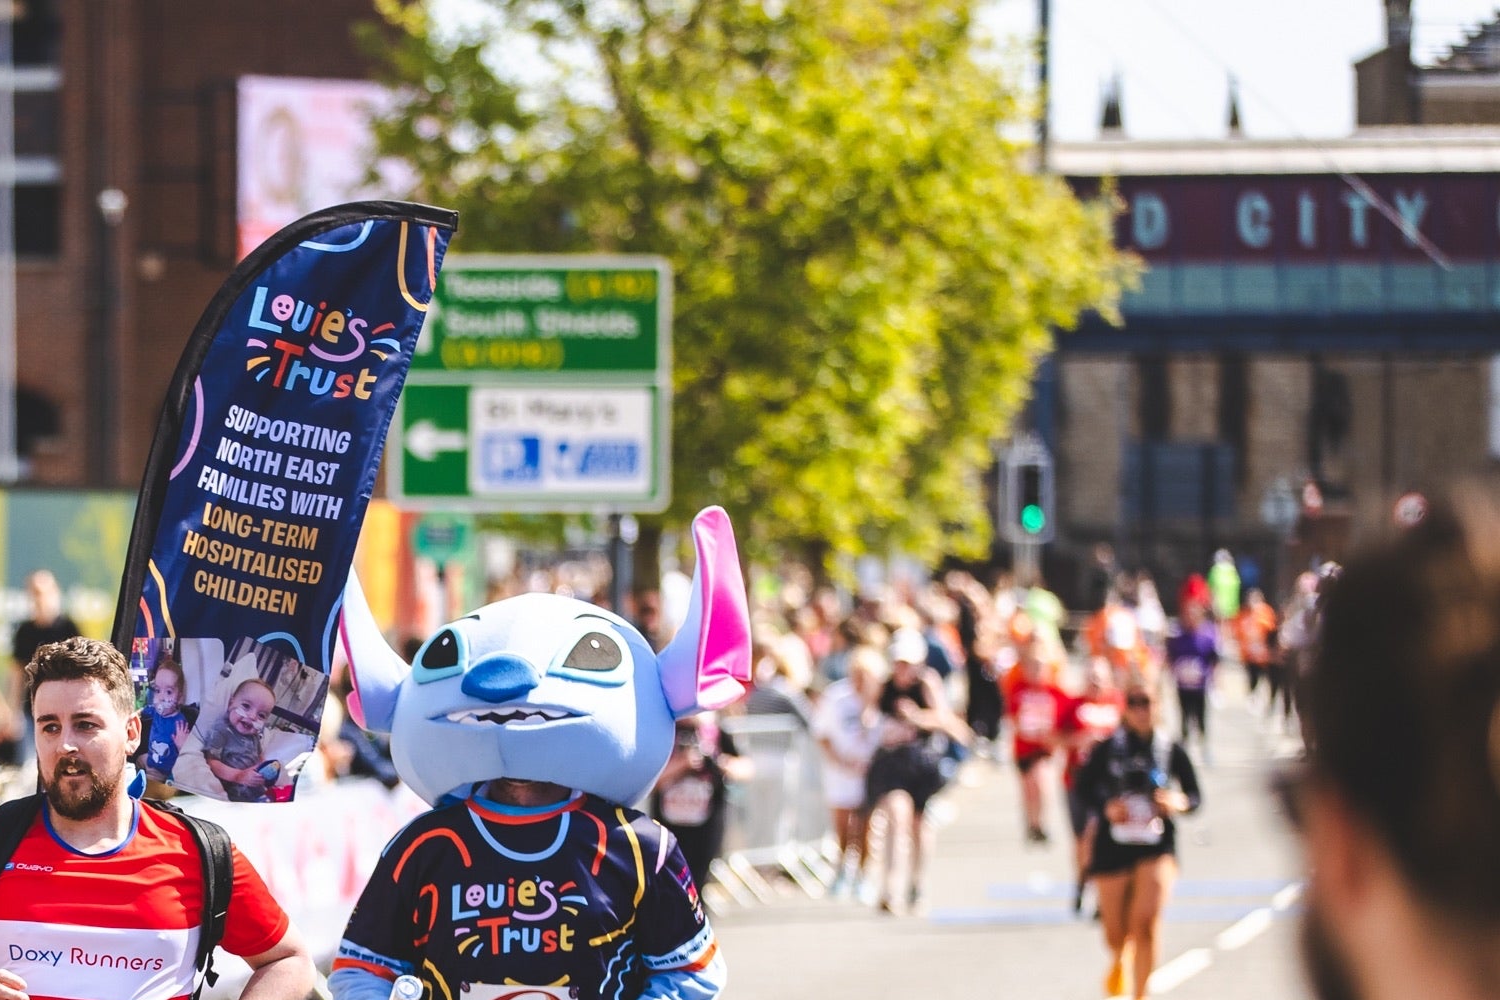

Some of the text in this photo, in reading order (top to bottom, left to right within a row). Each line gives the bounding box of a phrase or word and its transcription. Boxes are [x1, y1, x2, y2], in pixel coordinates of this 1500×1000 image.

[1236, 189, 1427, 249] CITY
[247, 286, 368, 363] Louie's
[273, 339, 378, 401] Trust
[224, 404, 352, 455] SUPPORTING
[215, 437, 340, 486] NORTH EAST
[197, 465, 344, 520] FAMILIES WITH
[202, 502, 319, 551] LONG-TERM
[183, 530, 323, 585] HOSPITALISED
[194, 570, 298, 617] CHILDREN
[451, 874, 558, 921] Louie's
[9, 944, 164, 971] Doxy Runners
[477, 917, 575, 955] Trust
